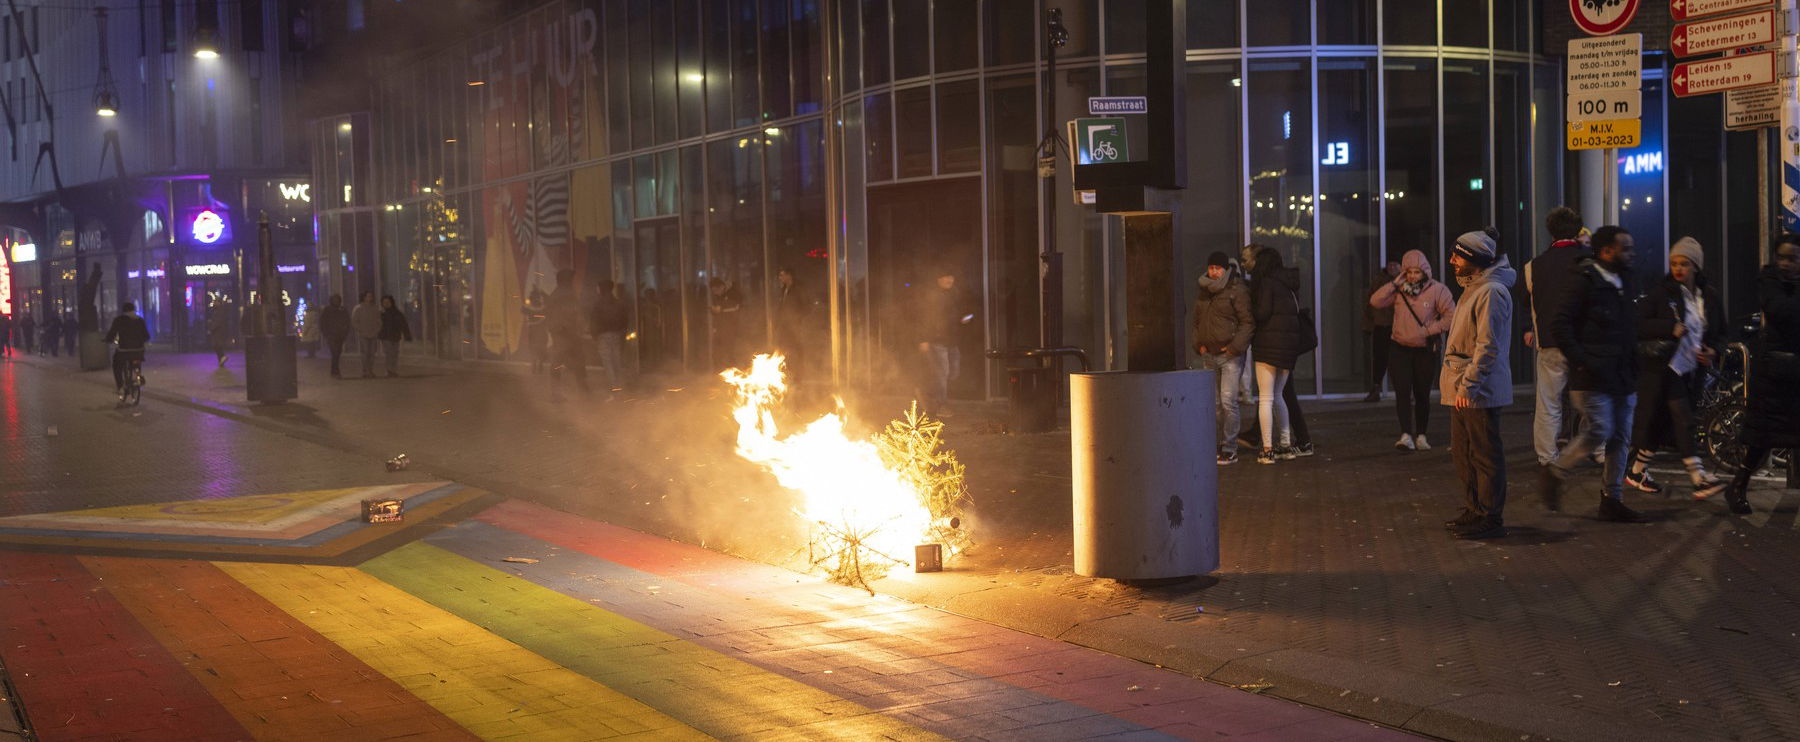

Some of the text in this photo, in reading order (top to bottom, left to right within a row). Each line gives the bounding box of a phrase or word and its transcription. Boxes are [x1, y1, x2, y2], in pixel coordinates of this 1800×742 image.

[1700, 0, 1732, 10] Centraal
[1688, 17, 1756, 35] Scheveningen
[1581, 39, 1626, 49] Uitgezonderd
[1689, 32, 1757, 49] Zoetermeer 13
[1570, 51, 1600, 60] maandag
[1615, 48, 1638, 58] vrijdag
[1689, 62, 1732, 75] Leiden 15
[1570, 71, 1600, 81] zaterdag
[1612, 69, 1637, 78] zondag
[1689, 73, 1752, 89] Rotterdam 19
[1092, 100, 1144, 110] Raamstraat
[1578, 99, 1628, 115] 100 m
[1735, 112, 1774, 123] herhaling
[1590, 124, 1613, 134] M.I.V.
[1572, 135, 1633, 147] 01-03-2023
